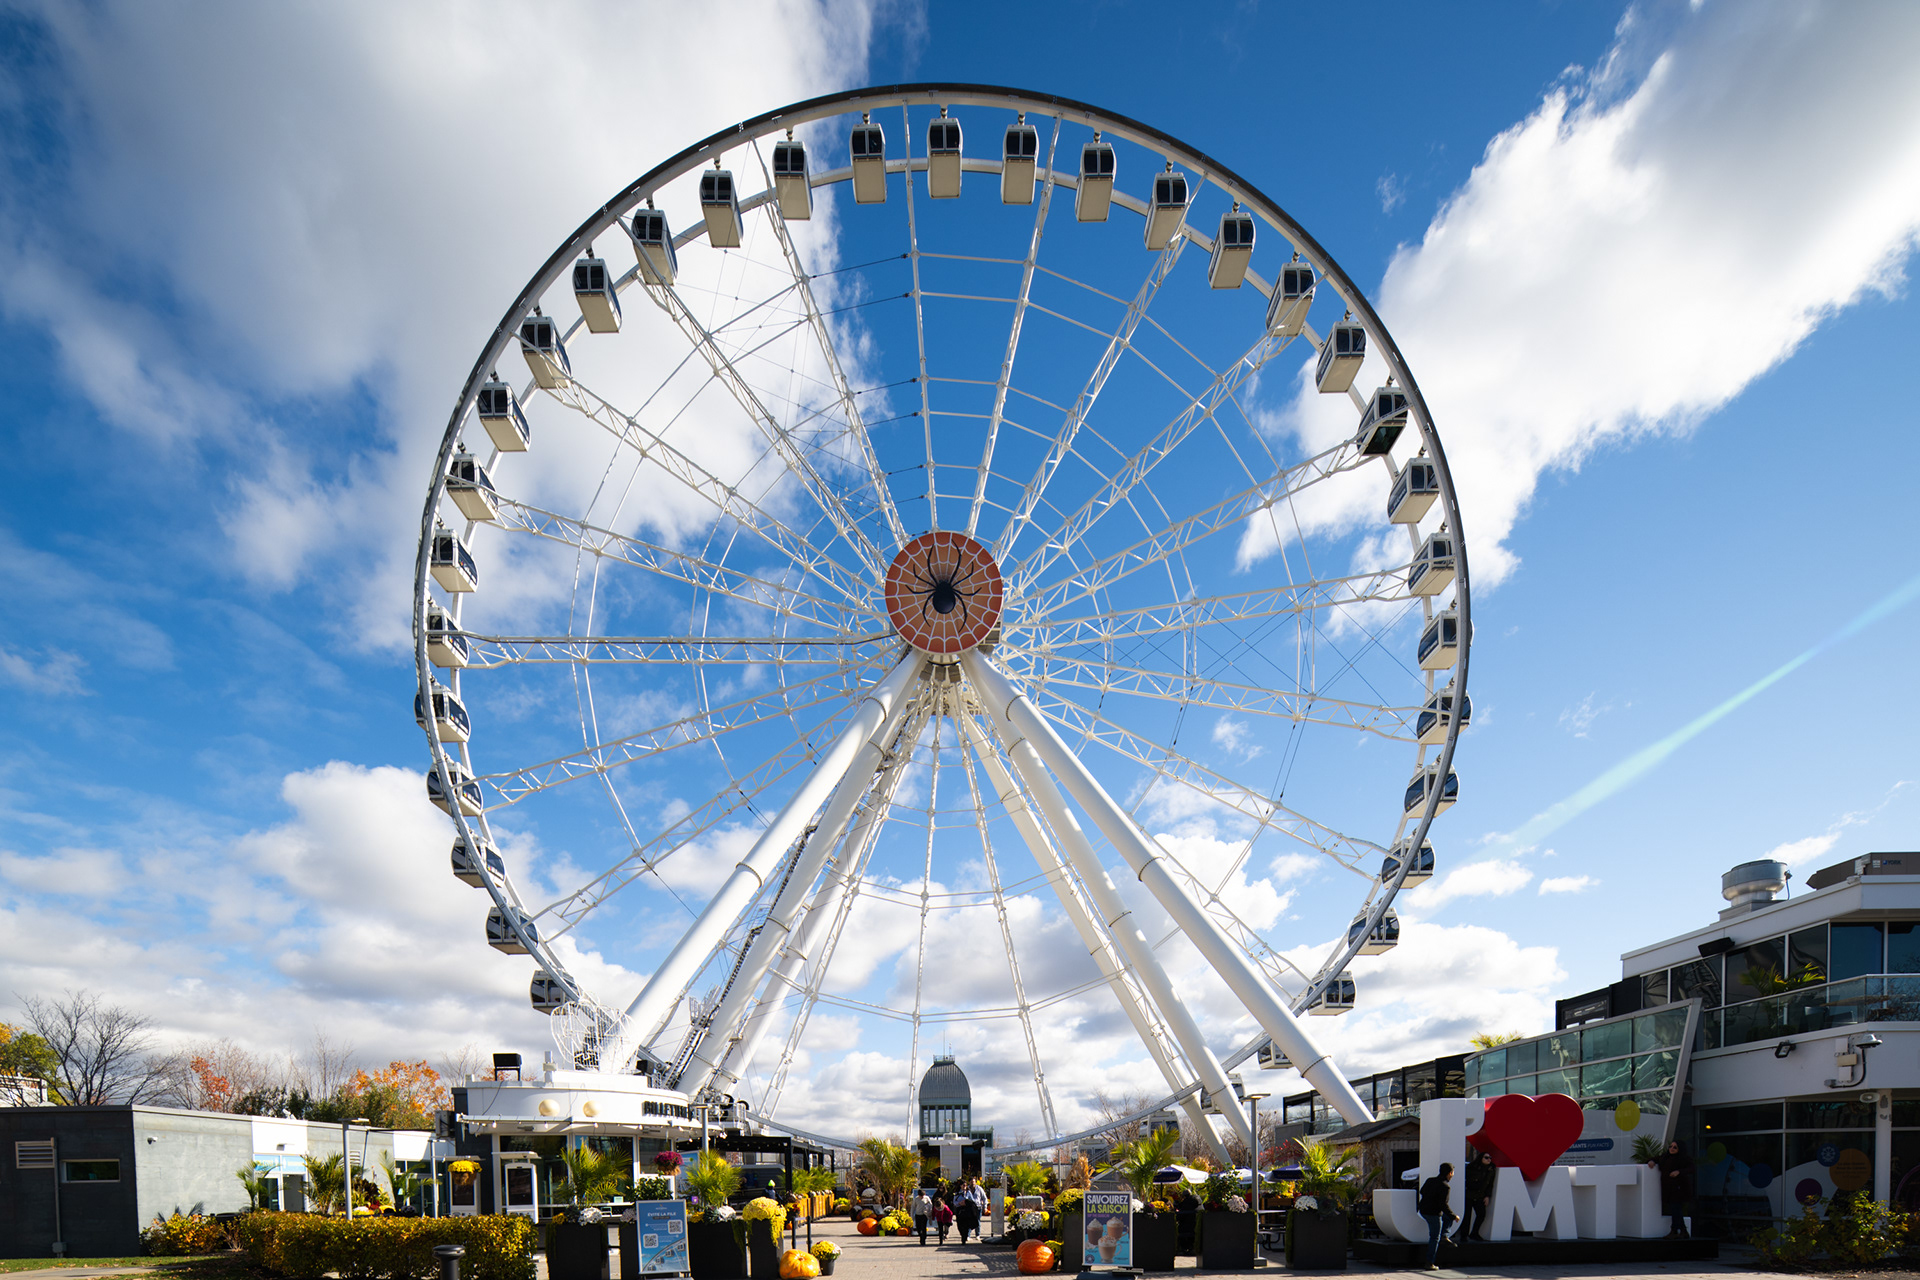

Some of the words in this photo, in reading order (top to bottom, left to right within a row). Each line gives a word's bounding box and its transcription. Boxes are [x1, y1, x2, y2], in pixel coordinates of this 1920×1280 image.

[1087, 1195, 1128, 1204] SAVOUREZ
[1481, 1165, 1691, 1241] MTL
[1087, 1204, 1096, 1213] LA
[1097, 1204, 1128, 1214] SAISON
